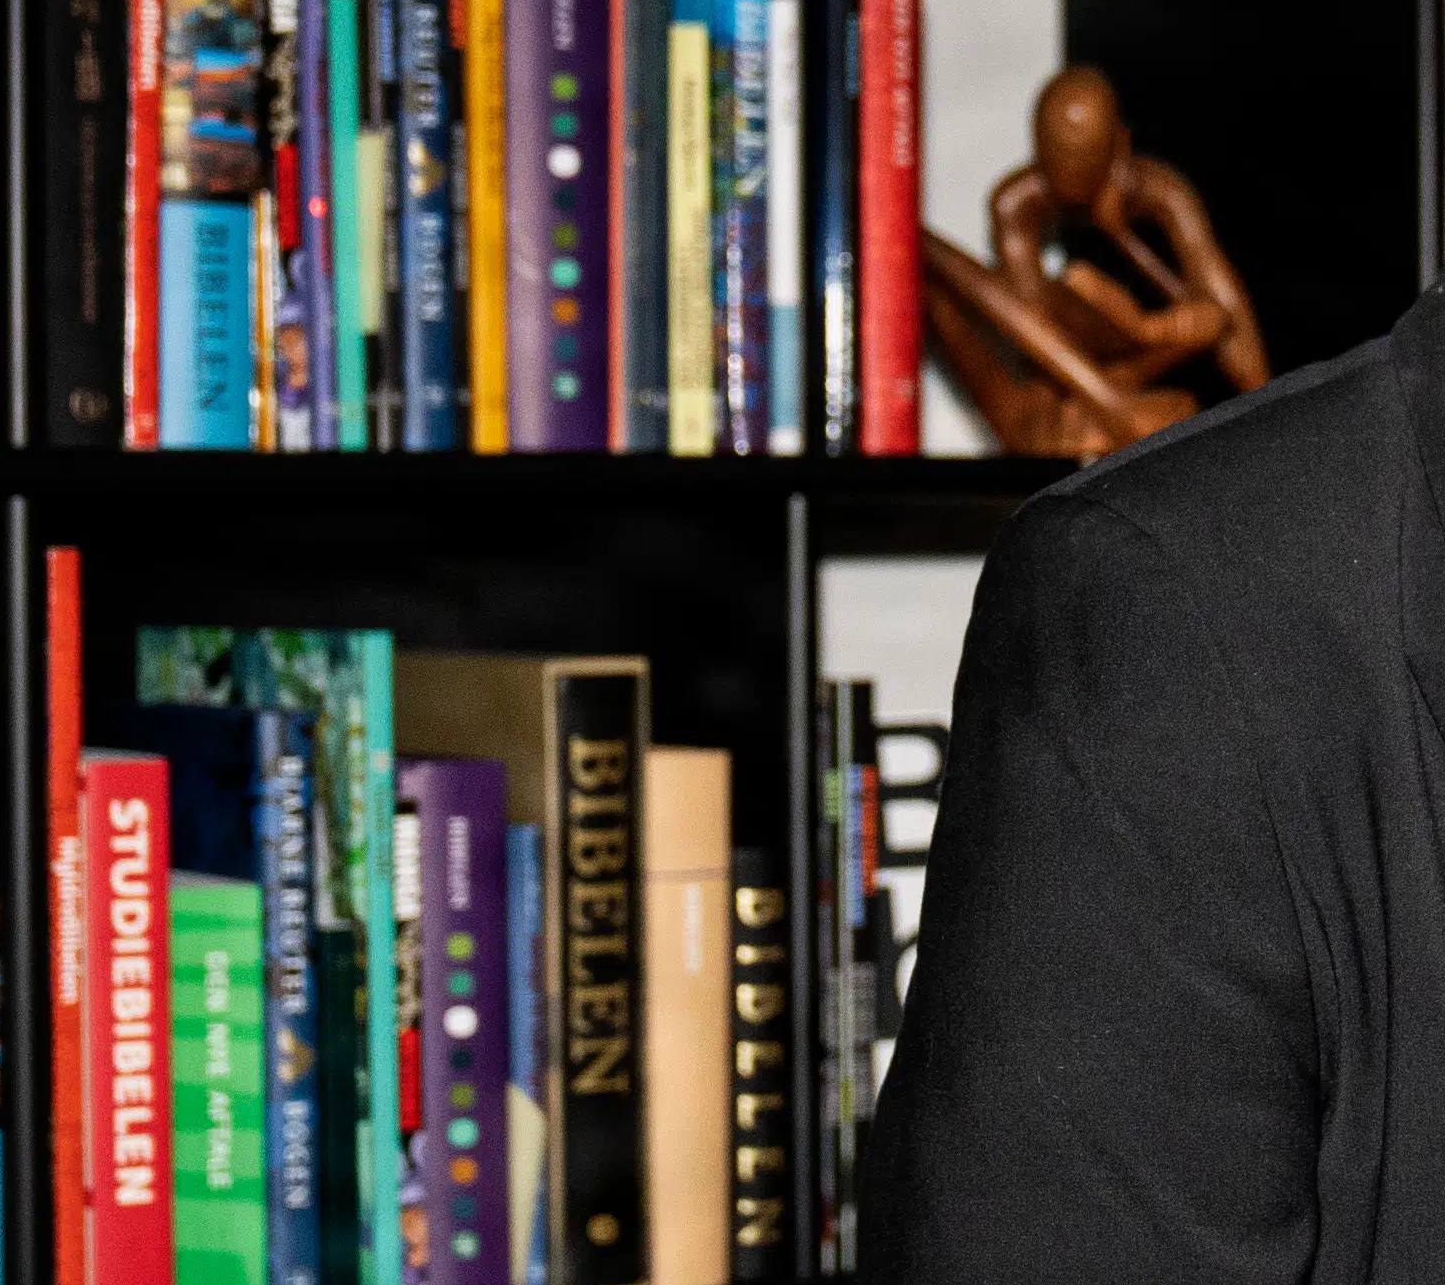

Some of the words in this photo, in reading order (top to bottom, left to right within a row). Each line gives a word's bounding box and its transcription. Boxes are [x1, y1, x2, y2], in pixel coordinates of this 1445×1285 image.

[107, 796, 155, 1206] STUDIEBIBELEN
[565, 733, 633, 1099] BIBELEN
[734, 886, 788, 1249] BIBELEN
